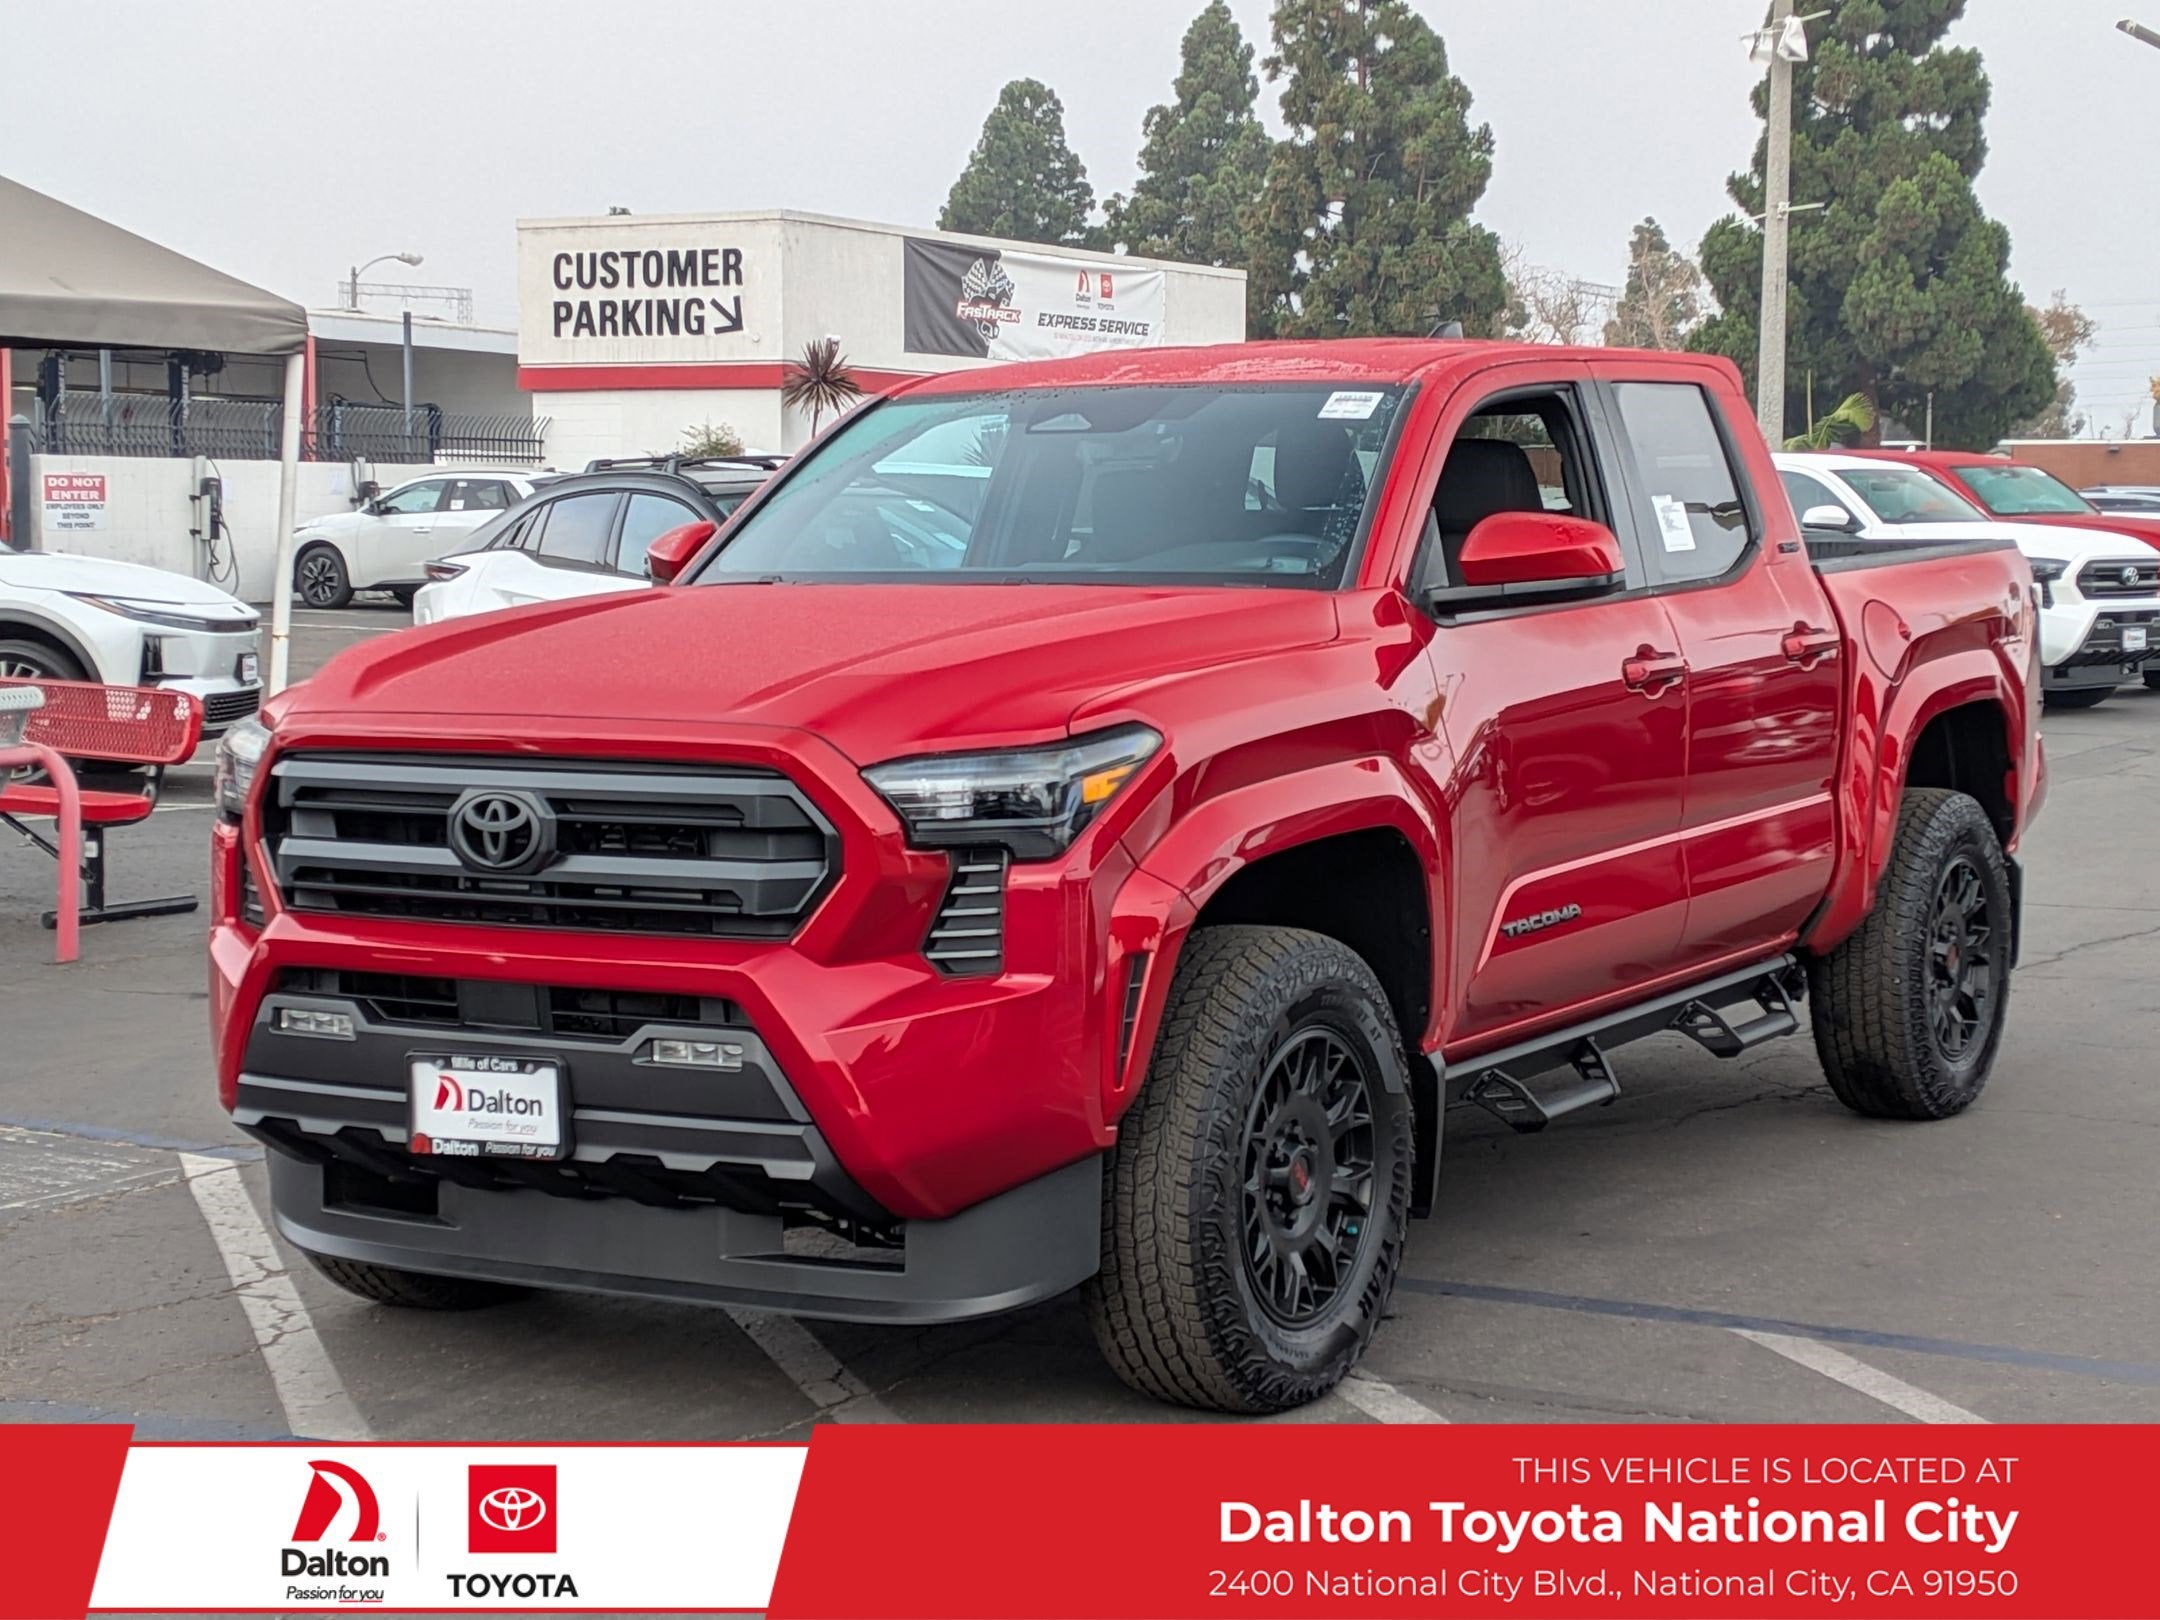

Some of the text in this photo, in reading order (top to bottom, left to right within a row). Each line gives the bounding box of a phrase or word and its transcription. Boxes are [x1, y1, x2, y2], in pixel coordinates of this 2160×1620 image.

[553, 248, 743, 290] CUSTOMER
[553, 297, 705, 338] PARKING
[1037, 312, 1150, 336] EXPRESS SERVICE
[47, 477, 102, 488] DO NOT
[51, 490, 100, 500] ENTER
[1502, 903, 1582, 937] TACOMA
[477, 1057, 490, 1070] of
[490, 1058, 518, 1072] Cars
[467, 1088, 543, 1117] Dalton
[432, 1138, 558, 1159] Dalton Passion for you
